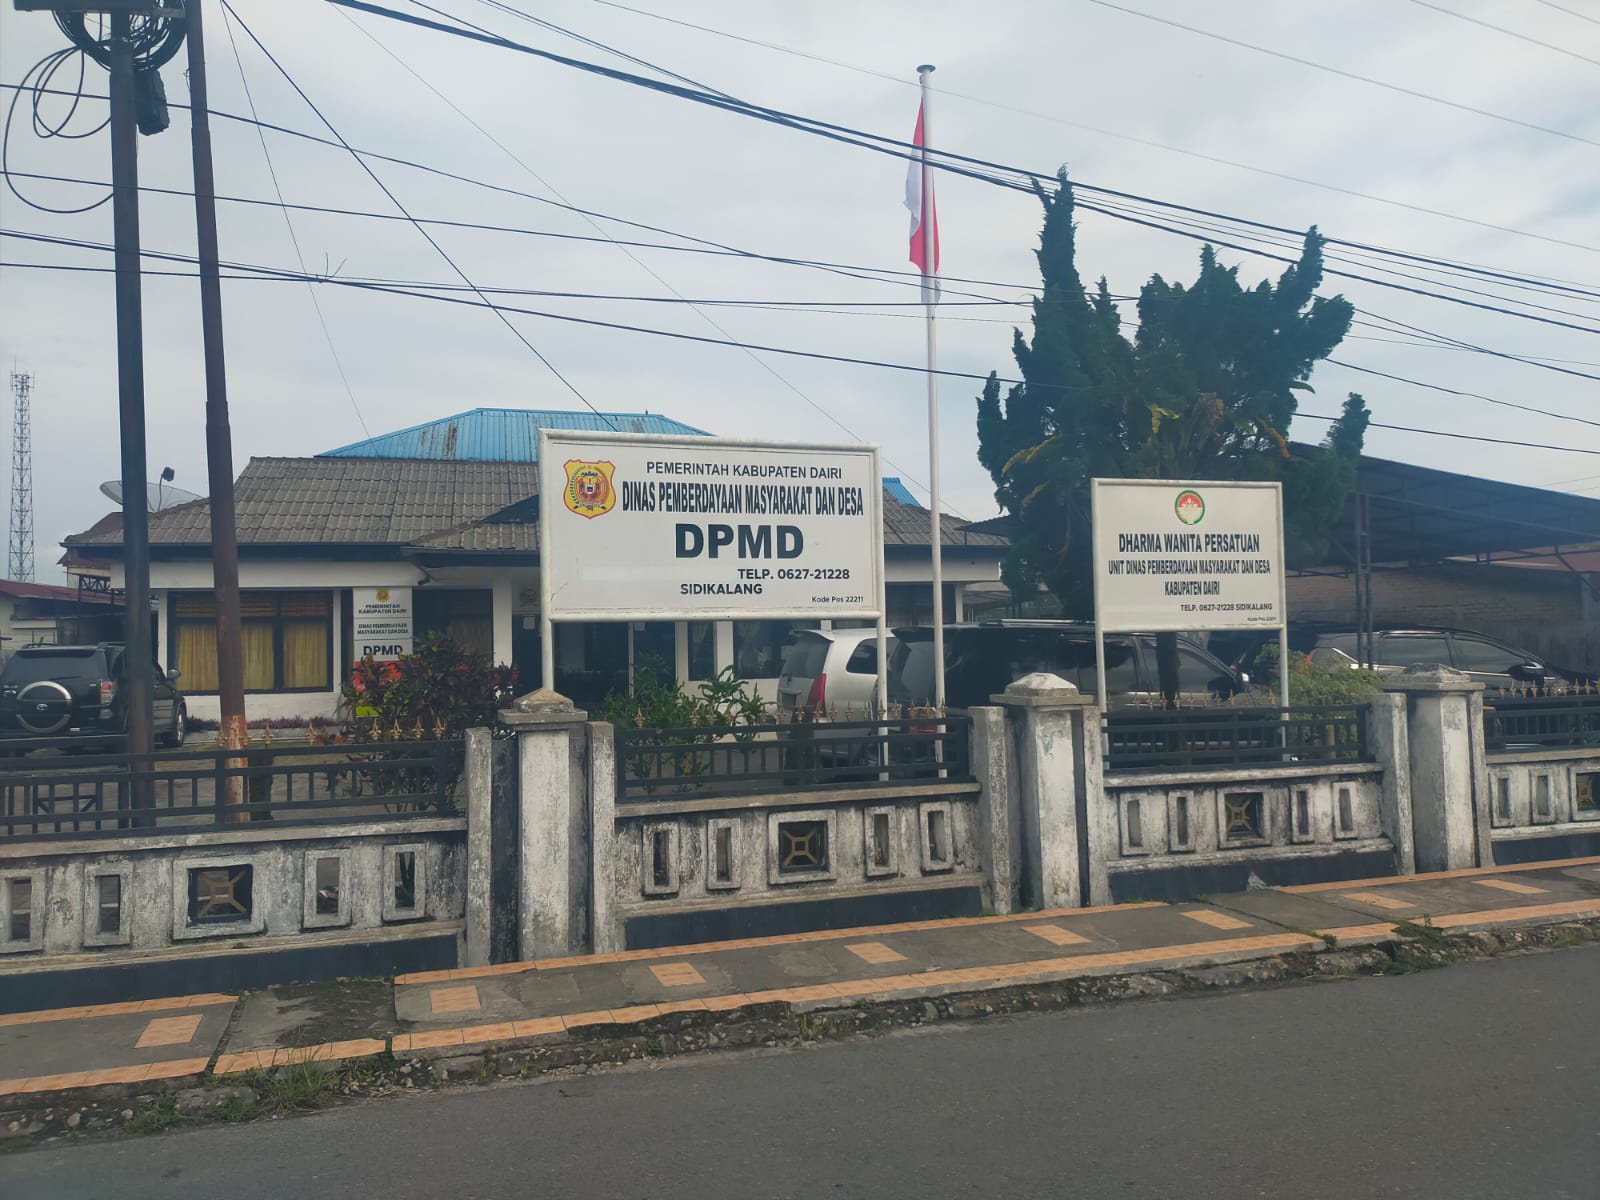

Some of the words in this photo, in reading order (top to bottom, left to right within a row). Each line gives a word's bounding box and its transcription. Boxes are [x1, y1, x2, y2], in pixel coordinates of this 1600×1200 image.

[647, 461, 729, 476] PEMERINTAH
[733, 464, 806, 478] KABUPATEN
[810, 466, 842, 479] DAIRI
[622, 481, 656, 512] DINAS
[658, 482, 742, 513] PEMBERDAYAAN
[745, 484, 812, 515] MASYARAKAT
[815, 486, 835, 515] DAN
[838, 486, 864, 516] DESA
[675, 523, 804, 559] DPMD
[1118, 533, 1162, 553] DHARMA
[1164, 533, 1203, 553] WANITA
[1204, 533, 1260, 553] PERSATUAN
[738, 568, 774, 581] TELP.
[777, 568, 850, 580] 0627-21228
[1108, 560, 1125, 575] UNIT
[1126, 560, 1146, 575] DINAS
[1147, 559, 1198, 575] PEMBERDAYAAN
[1199, 559, 1240, 574] MASYARAKAT
[1241, 559, 1254, 574] DAN
[1255, 559, 1270, 574] DESA
[680, 583, 763, 595] SIDIKALANG
[1164, 581, 1202, 596] KABUPATEN
[1203, 581, 1220, 595] DAIRI
[1180, 604, 1198, 612] TELP.
[1199, 604, 1235, 612] 0627-21228
[1236, 603, 1273, 611] SIDIKALANG
[363, 645, 403, 656] DPMD
